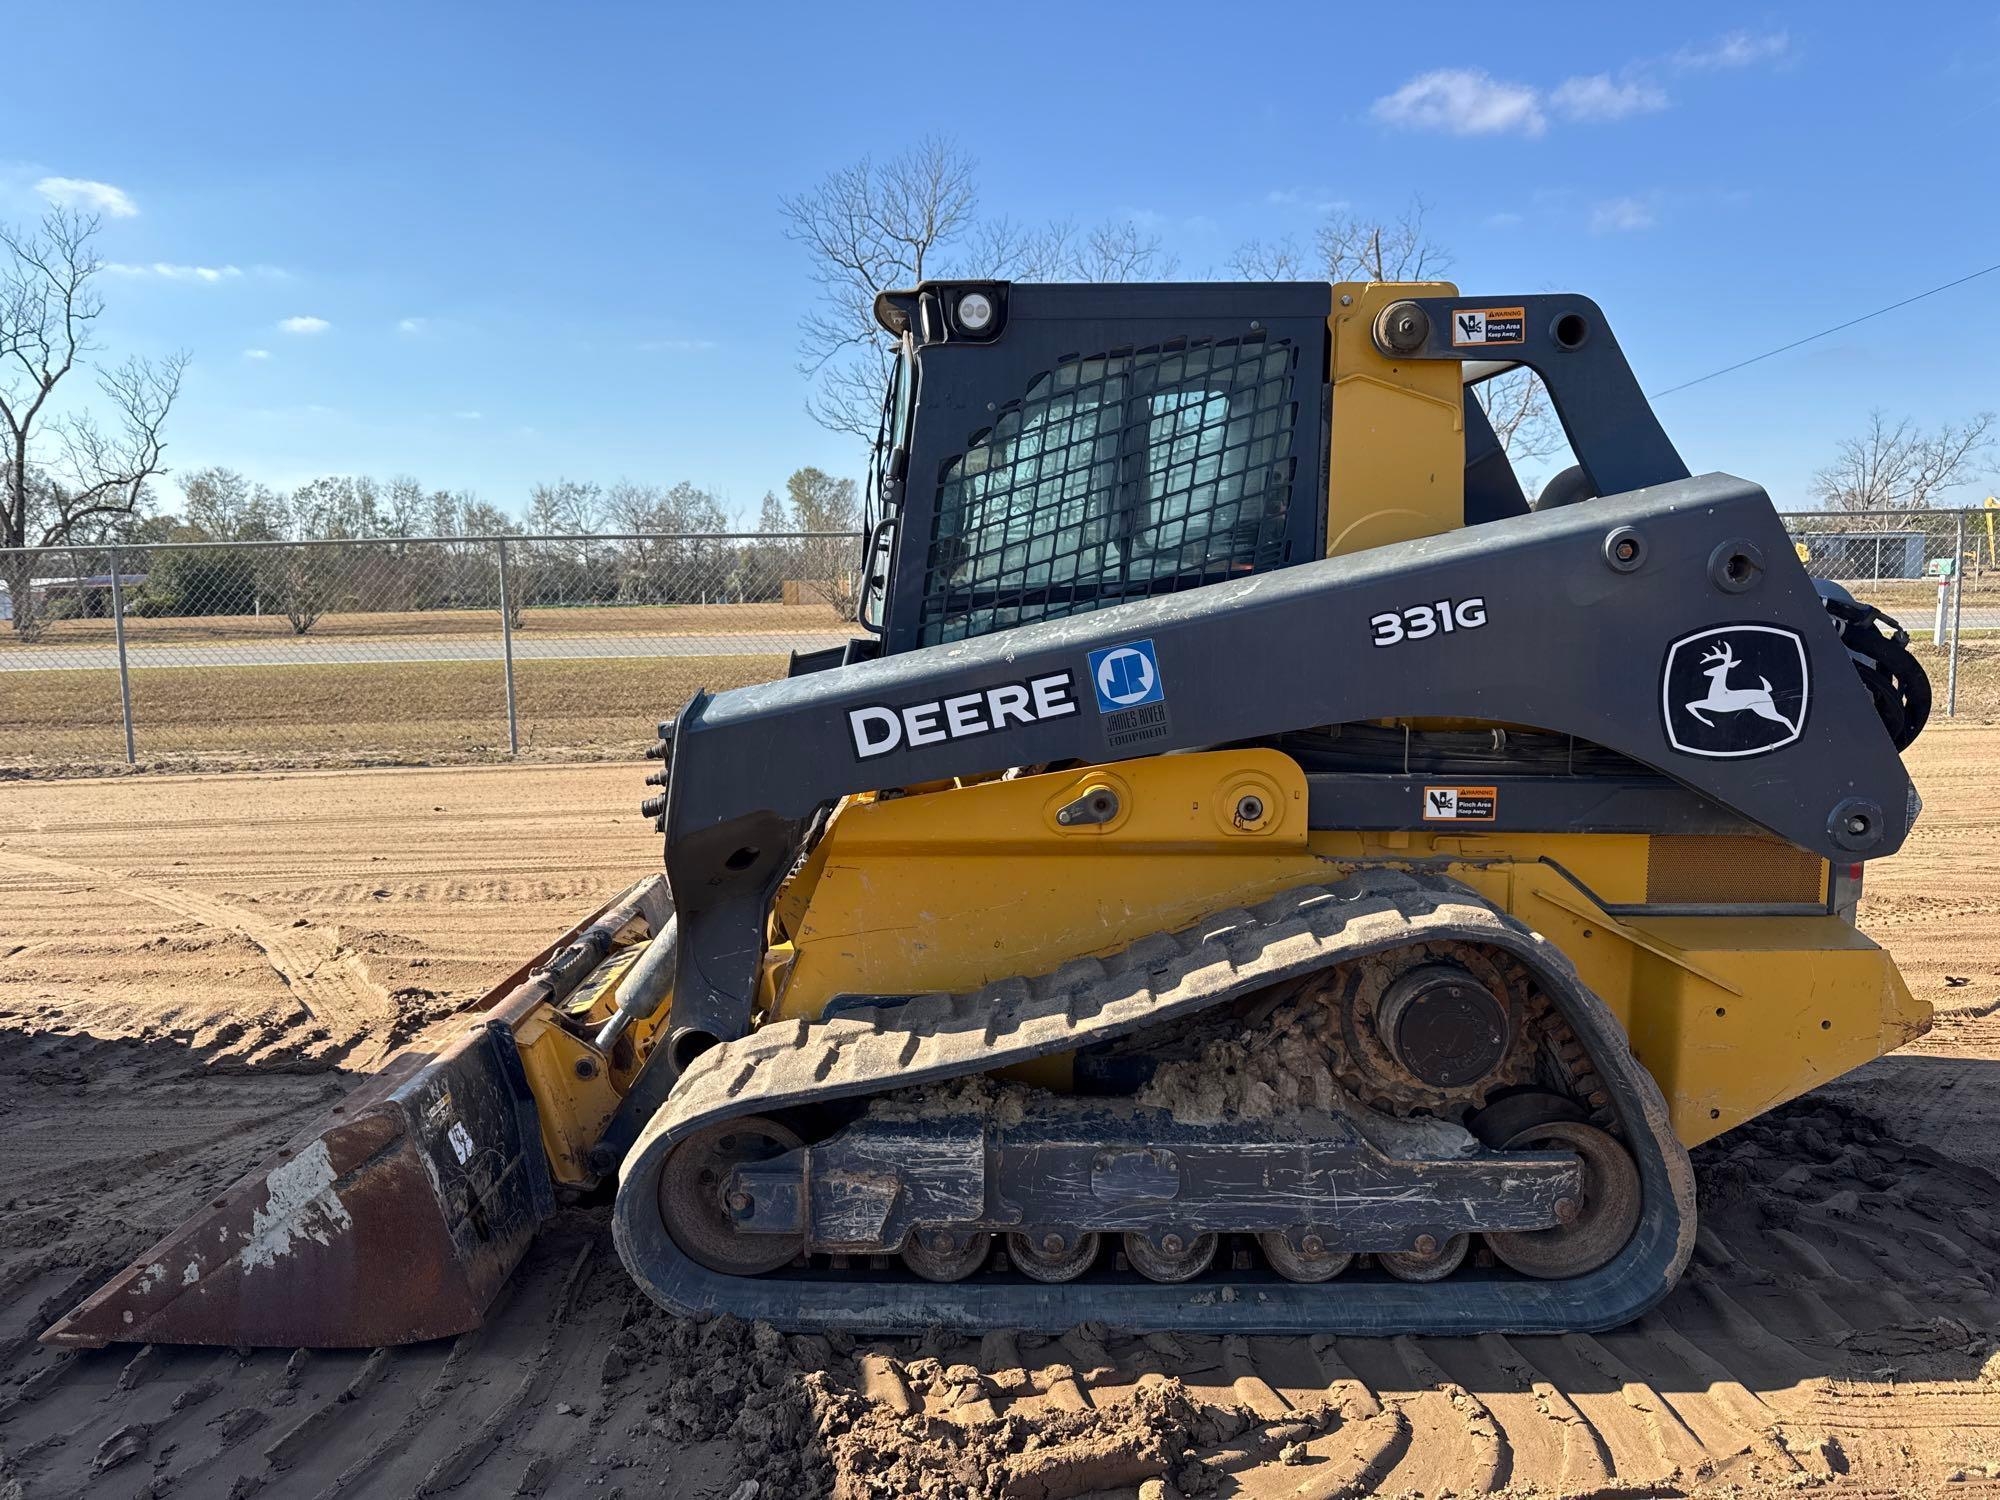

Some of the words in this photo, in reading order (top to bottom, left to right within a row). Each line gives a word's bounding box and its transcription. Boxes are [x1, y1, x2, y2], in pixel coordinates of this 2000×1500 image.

[1494, 310, 1522, 318] WARNING
[1370, 598, 1487, 646] 331G
[848, 673, 1076, 758] DEERE
[1106, 710, 1138, 733] JAMES
[1139, 704, 1166, 726] RIVER
[1108, 725, 1168, 747] EQUIPMENT
